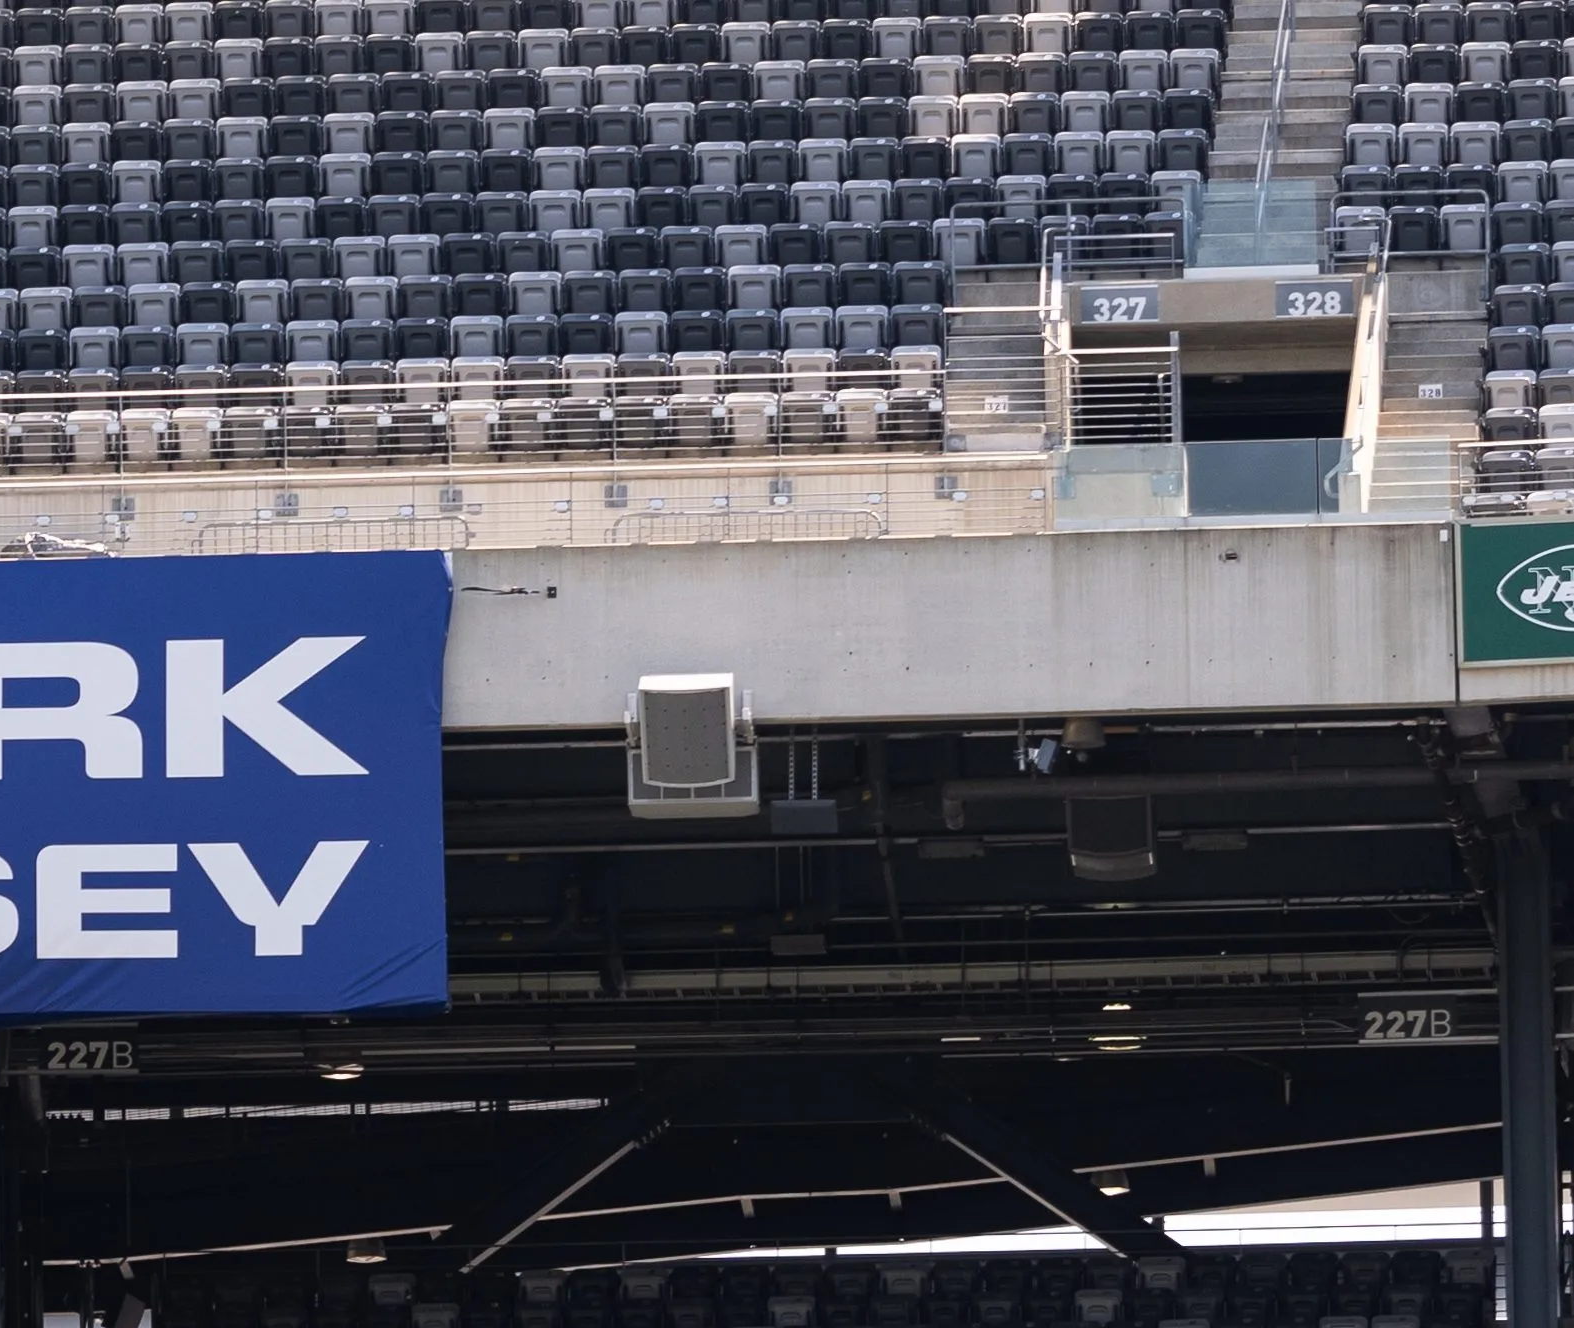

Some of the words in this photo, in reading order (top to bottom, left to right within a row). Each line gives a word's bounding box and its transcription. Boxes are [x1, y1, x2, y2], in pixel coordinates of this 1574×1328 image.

[1092, 296, 1147, 322] 327
[1287, 290, 1343, 317] 328
[1420, 388, 1441, 398] 328
[1364, 1009, 1451, 1039] 227B
[48, 1041, 133, 1070] 227B
